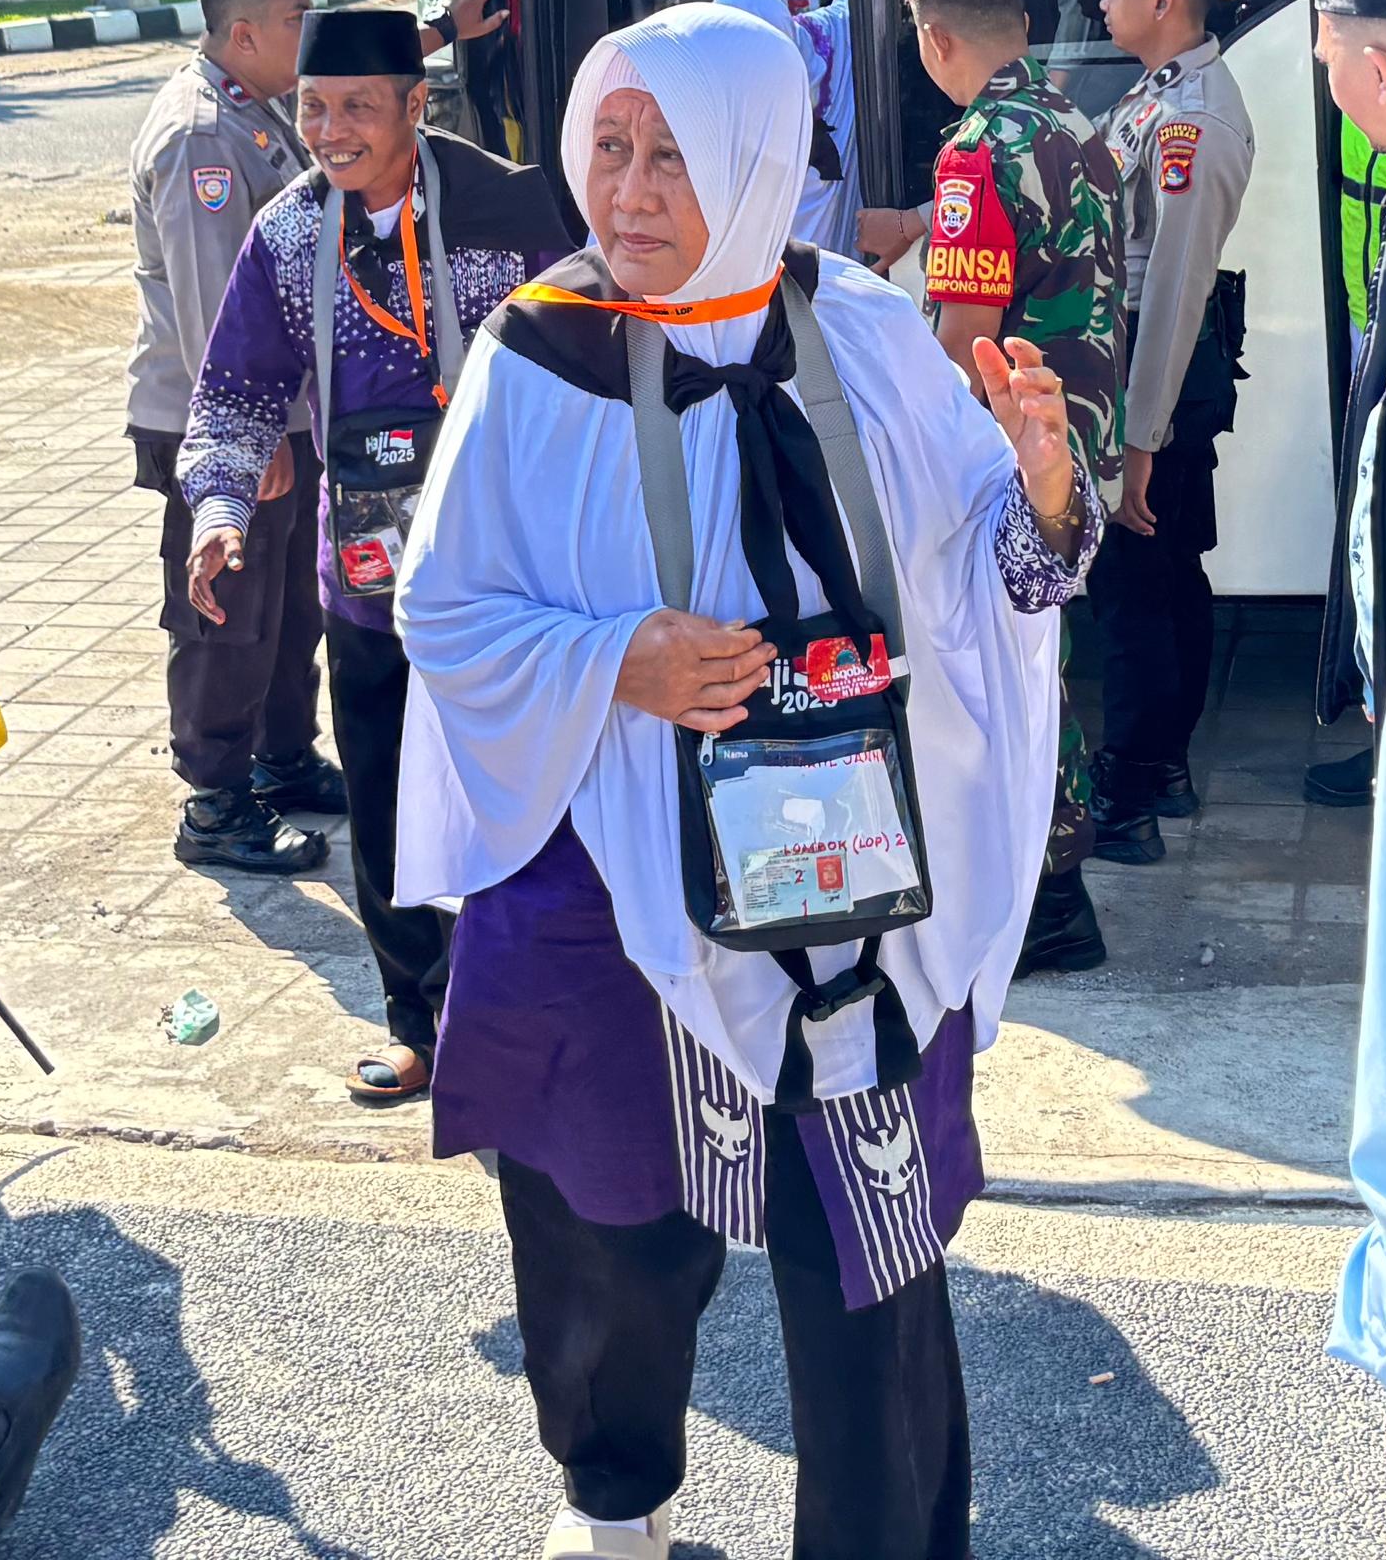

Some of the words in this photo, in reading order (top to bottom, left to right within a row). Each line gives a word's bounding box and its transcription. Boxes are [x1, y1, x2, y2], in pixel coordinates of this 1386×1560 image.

[980, 282, 1012, 295] BARU
[675, 306, 693, 316] LOP
[365, 431, 390, 462] Haji
[379, 448, 416, 466] 2025
[723, 749, 749, 759] Nama
[852, 831, 890, 855] (LOP)
[894, 832, 906, 847] 2
[794, 869, 805, 884] 2
